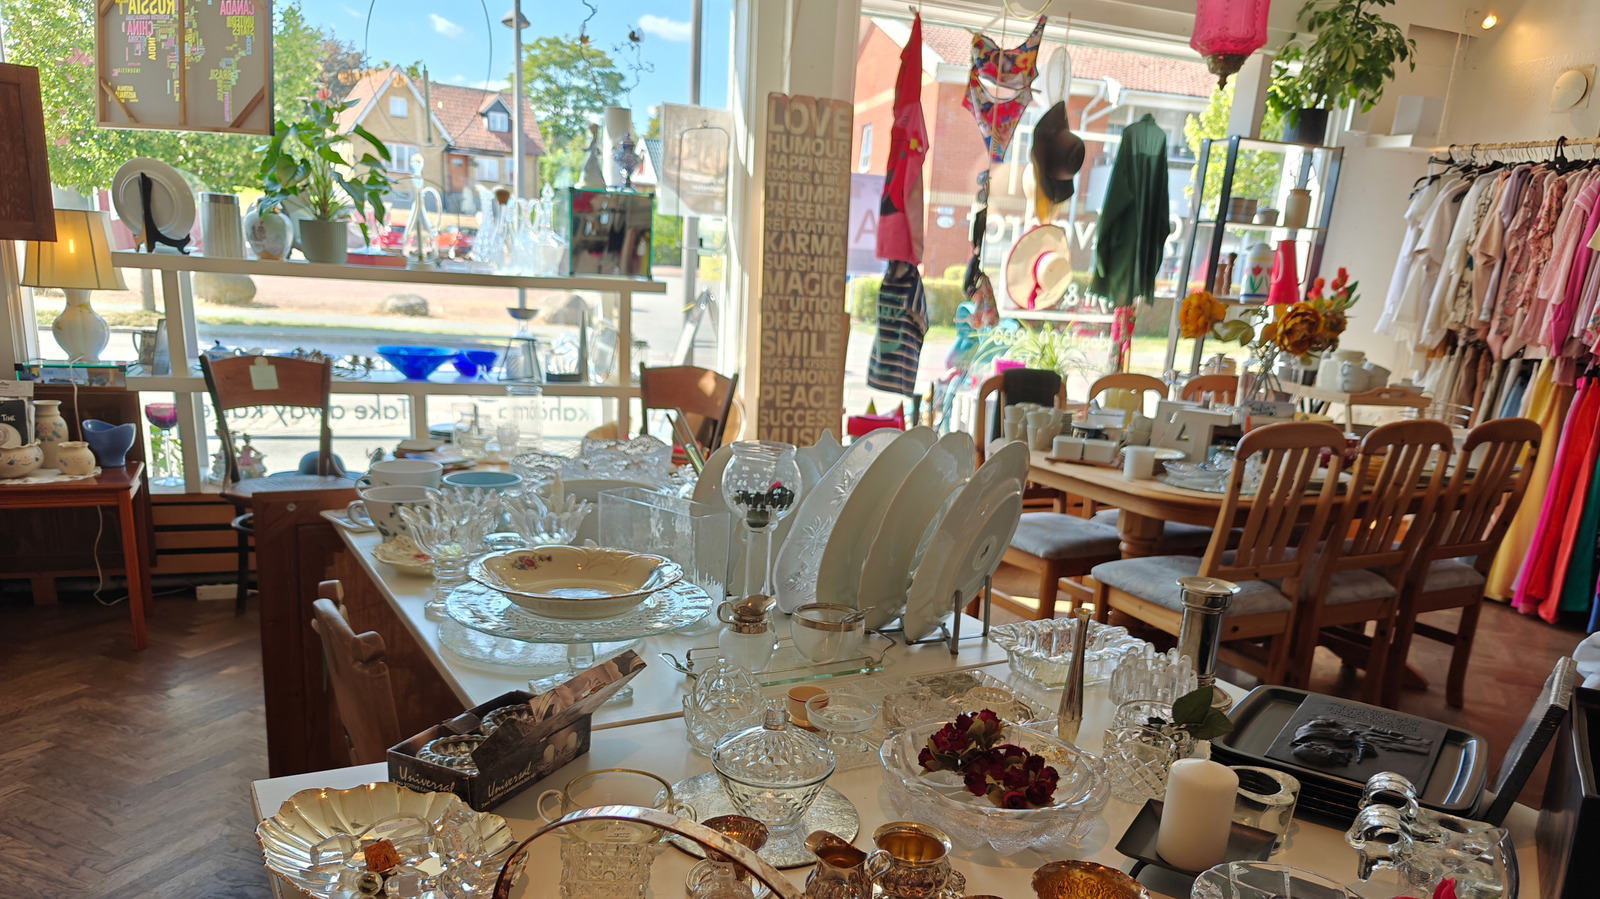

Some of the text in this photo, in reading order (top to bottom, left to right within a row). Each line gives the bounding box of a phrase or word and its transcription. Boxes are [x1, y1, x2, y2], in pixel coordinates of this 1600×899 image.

[768, 100, 851, 140] LOVE
[767, 133, 850, 159] HUMOUR
[766, 153, 850, 175] HAPPINESS
[766, 180, 848, 205] TRIUMPH
[765, 200, 847, 222] PRESENTS
[765, 218, 846, 236] RELAXATION
[764, 230, 844, 257] KARMA
[764, 253, 844, 274] SUNSHINE
[763, 268, 843, 298] MAGIC
[763, 294, 843, 315] INTUITION
[762, 311, 841, 333] DREAMS
[761, 329, 840, 358] SMILE
[761, 366, 839, 386] HARMONY
[760, 384, 839, 409] PEACE
[759, 407, 836, 427] SUCCESS
[399, 765, 455, 793] Universal
[488, 762, 532, 798] Universal
